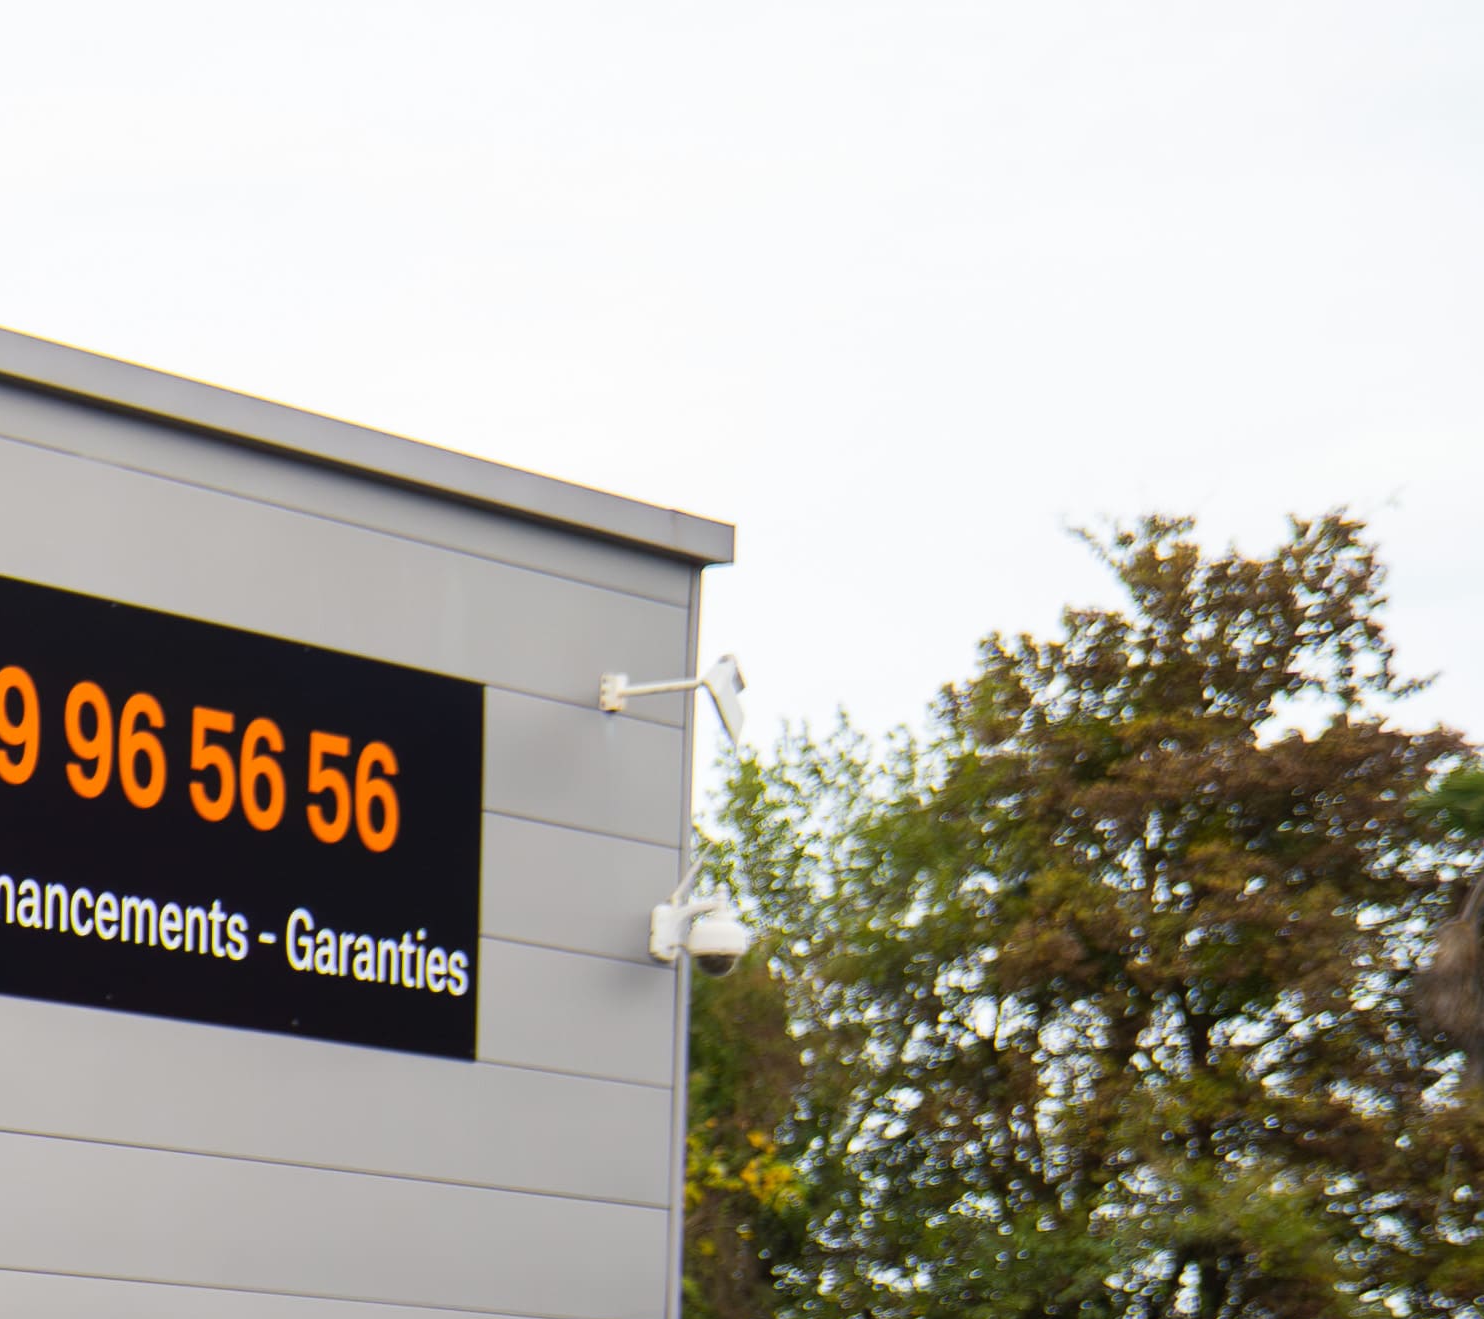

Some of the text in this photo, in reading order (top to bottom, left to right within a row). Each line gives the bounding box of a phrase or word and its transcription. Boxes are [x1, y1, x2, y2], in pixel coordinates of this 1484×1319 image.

[65, 681, 167, 809] 96
[189, 706, 285, 832] 56
[307, 731, 400, 853] 56
[286, 908, 469, 997] Garanties
